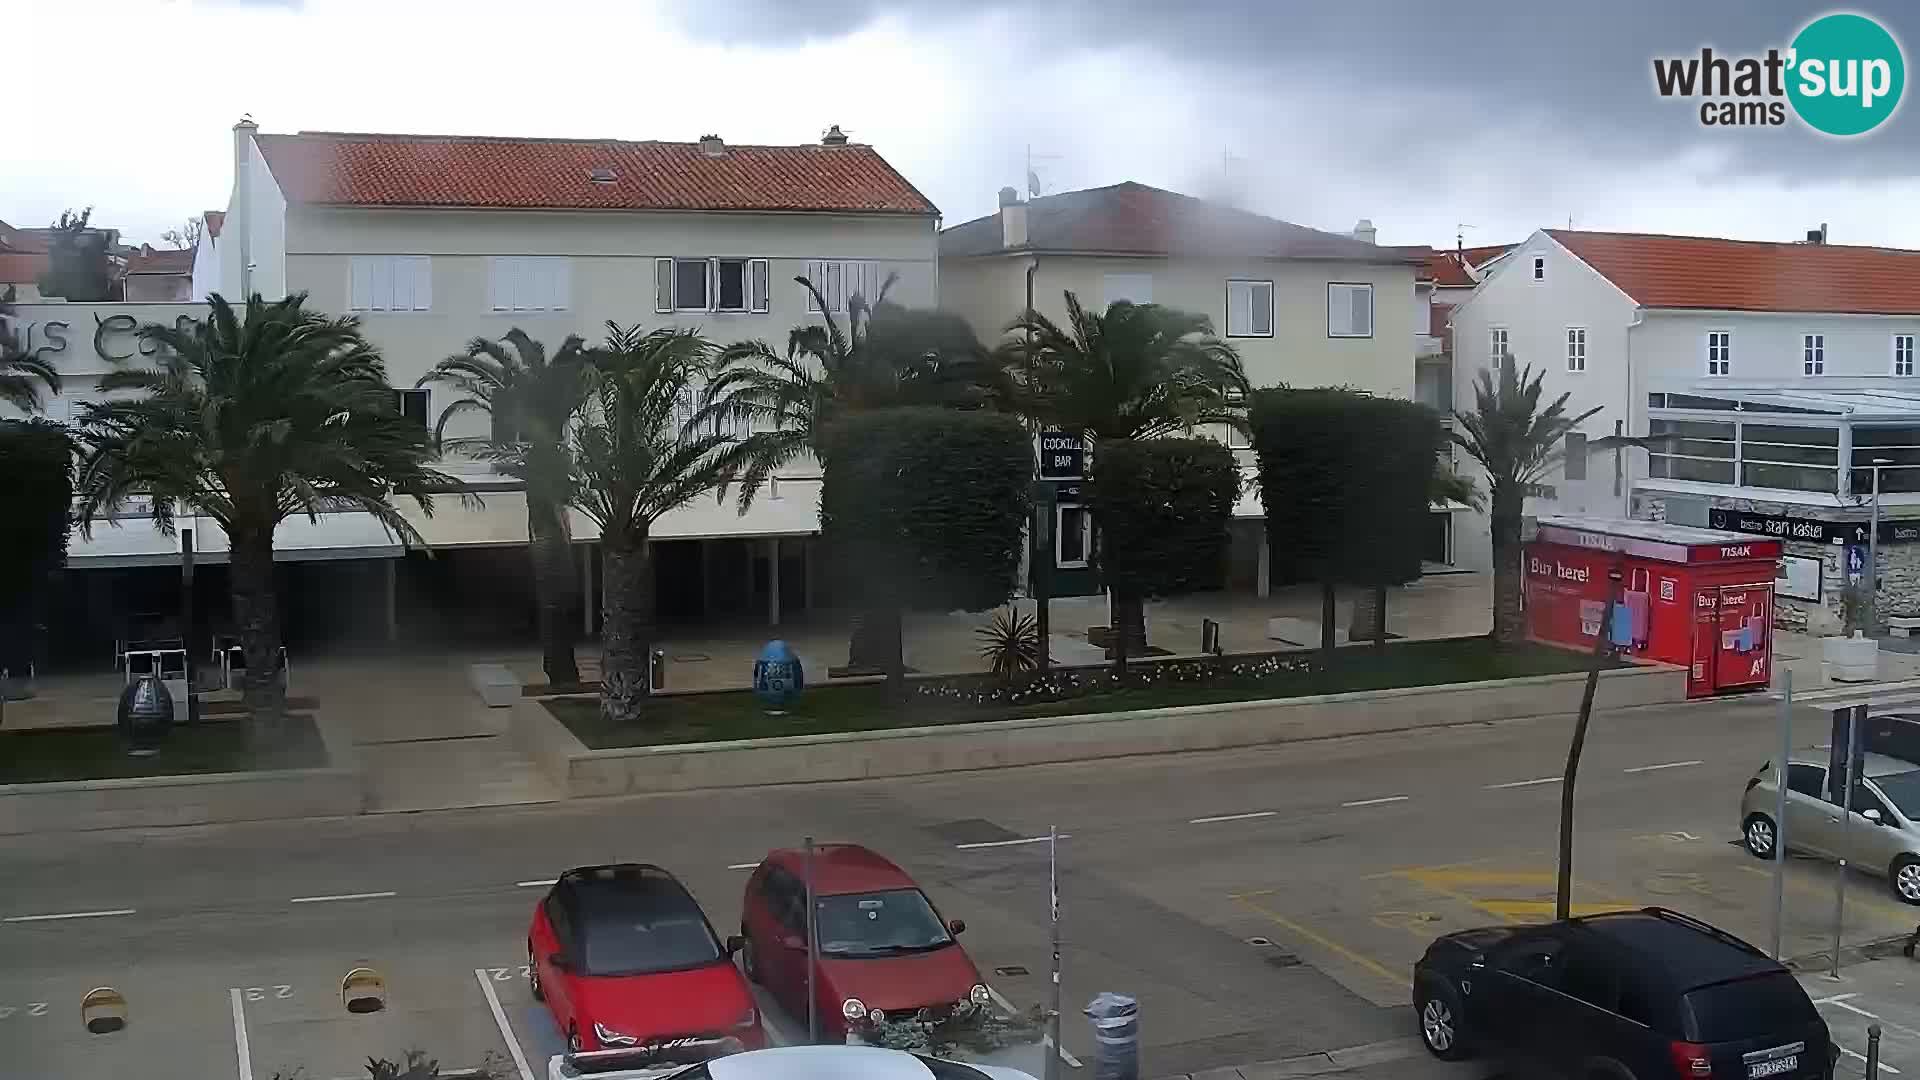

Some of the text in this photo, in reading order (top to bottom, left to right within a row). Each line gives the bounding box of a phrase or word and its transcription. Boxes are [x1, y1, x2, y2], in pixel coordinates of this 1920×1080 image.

[1054, 455, 1072, 467] BAR
[1720, 545, 1750, 558] TISAK
[1531, 558, 1590, 582] Buy here!
[1698, 594, 1717, 608] Buy
